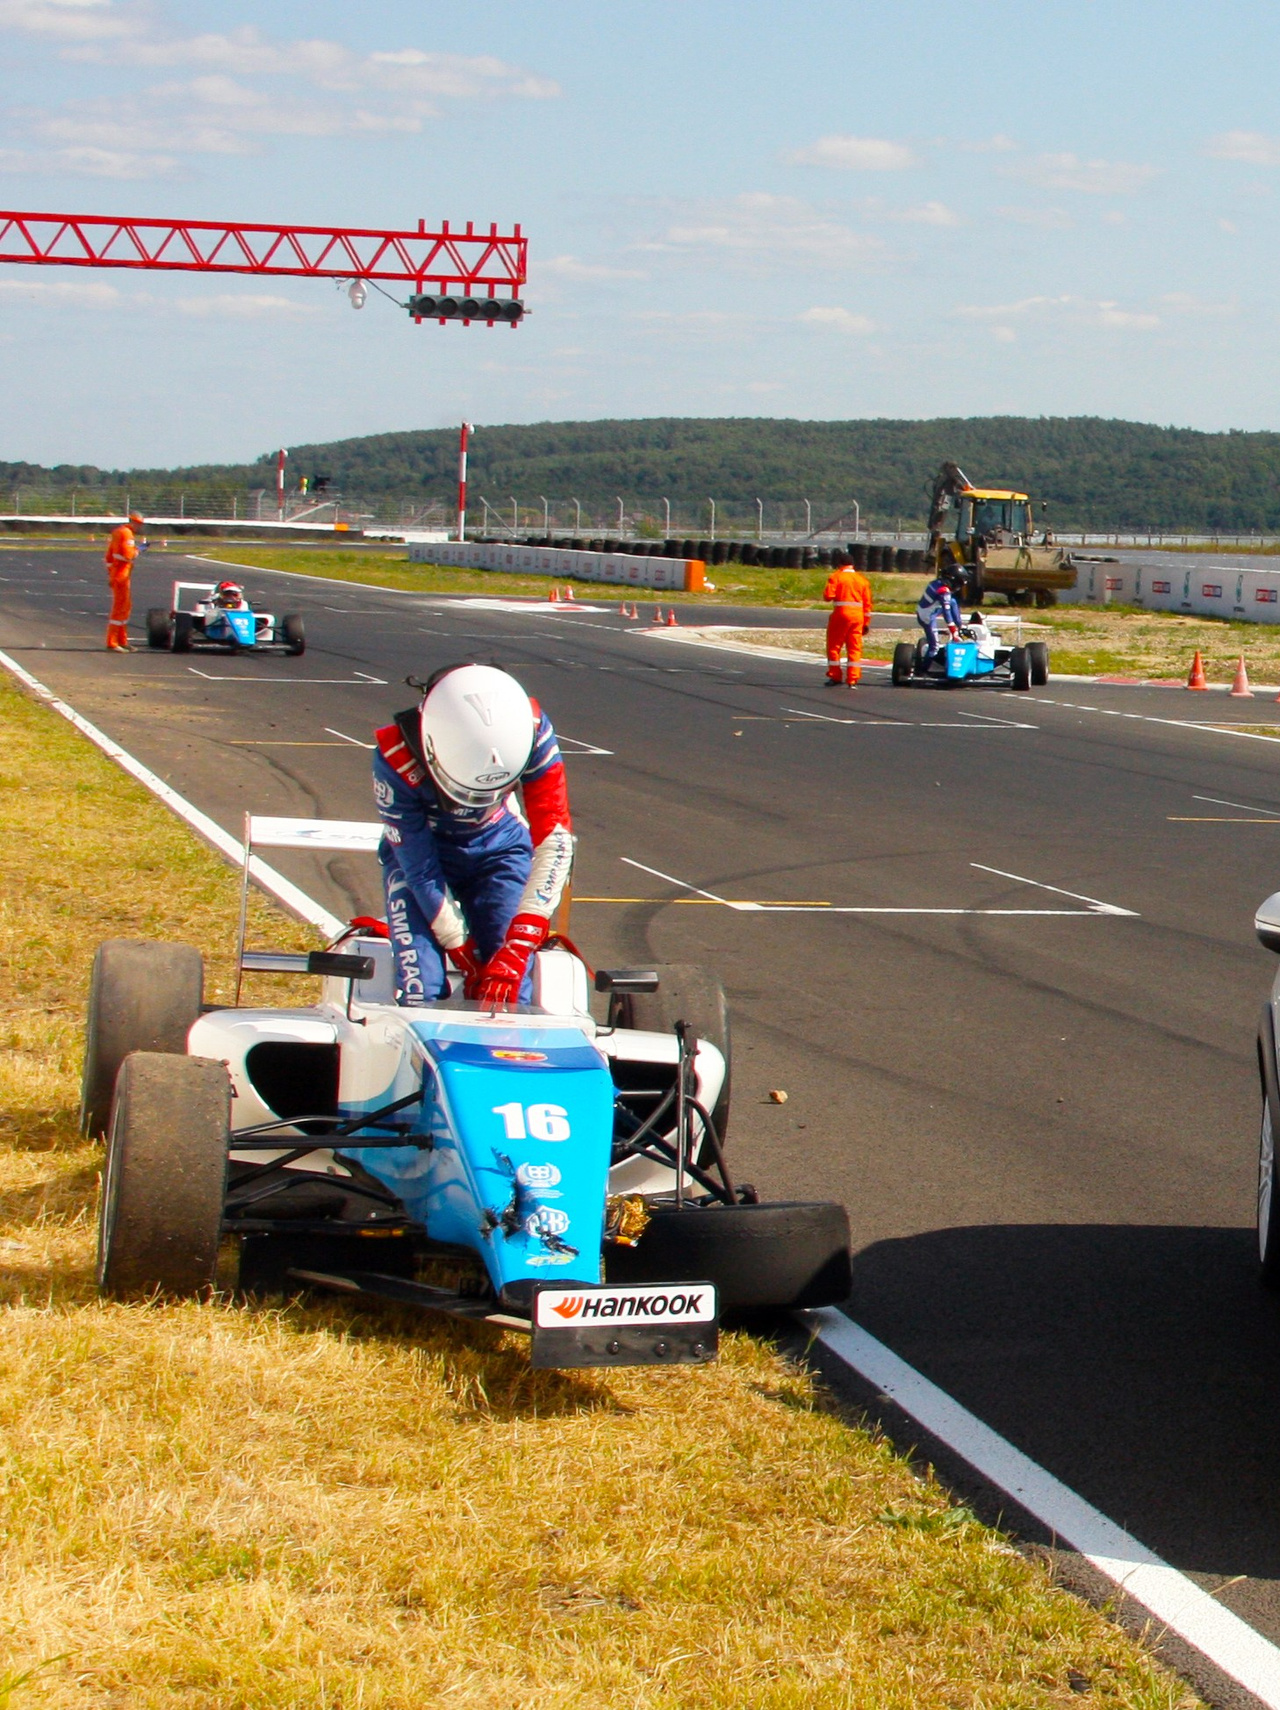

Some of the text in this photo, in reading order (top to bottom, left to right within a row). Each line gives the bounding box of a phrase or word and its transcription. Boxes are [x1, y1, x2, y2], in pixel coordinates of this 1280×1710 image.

[391, 899, 413, 946] SMP
[491, 1102, 571, 1142] 16
[581, 1293, 704, 1318] HANKOOK
